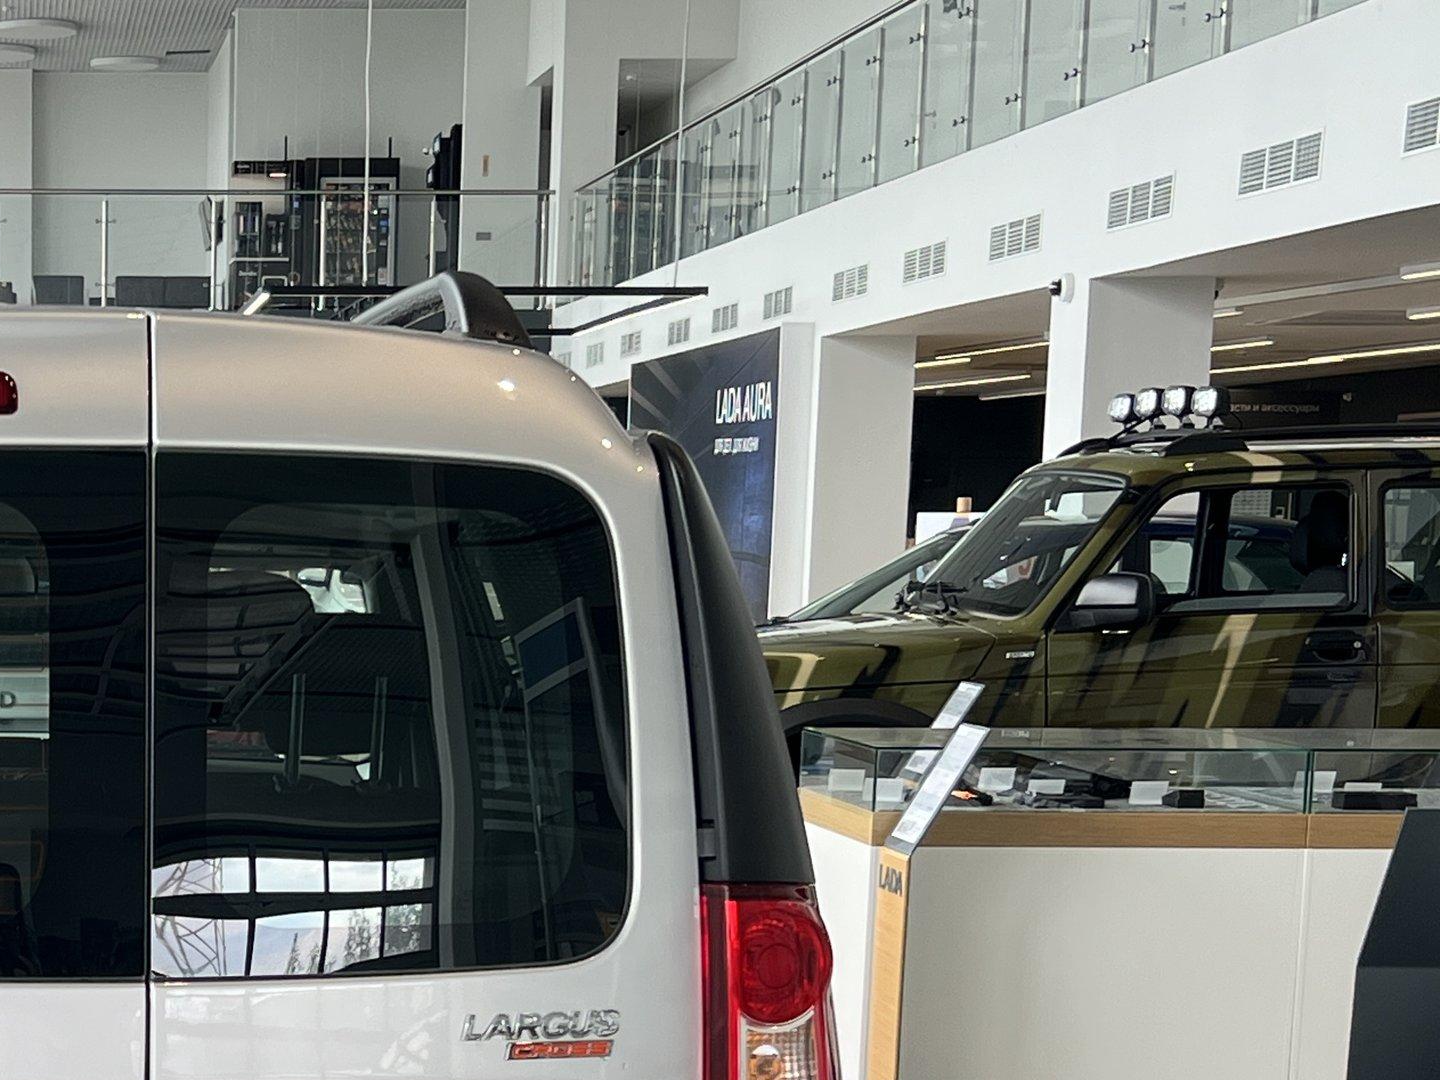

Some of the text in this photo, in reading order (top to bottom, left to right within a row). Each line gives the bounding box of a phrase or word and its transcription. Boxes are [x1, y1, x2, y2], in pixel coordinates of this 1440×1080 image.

[716, 381, 772, 424] LADA AURA
[879, 864, 902, 897] LADA
[461, 1008, 621, 1042] LARGUS
